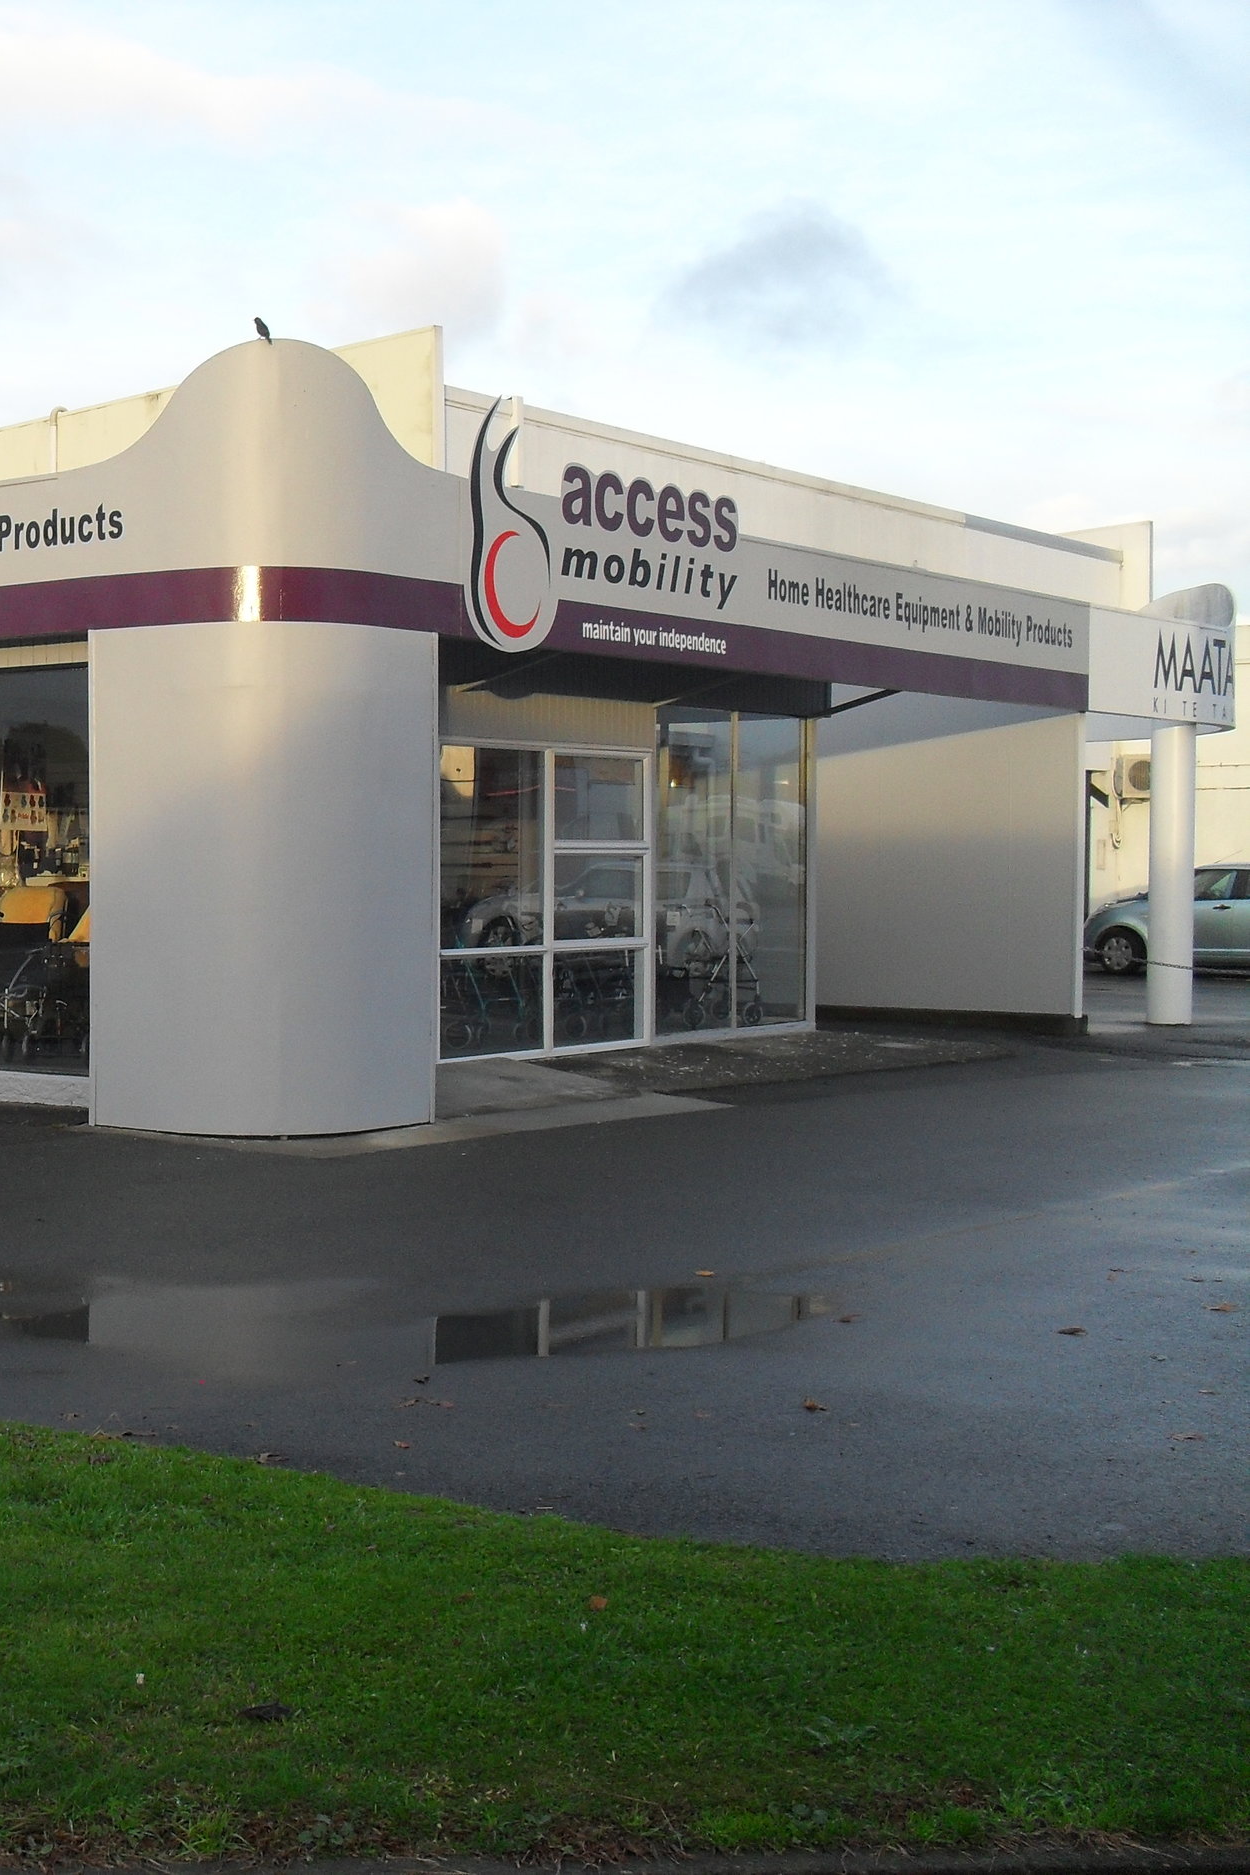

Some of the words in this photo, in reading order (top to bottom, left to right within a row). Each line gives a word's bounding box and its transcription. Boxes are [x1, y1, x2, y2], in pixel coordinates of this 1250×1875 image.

[561, 465, 738, 553] access
[560, 547, 738, 610] mobility
[767, 567, 810, 607] Home
[814, 576, 891, 620] Healthcare
[895, 591, 961, 633] Equipment
[964, 603, 974, 632] &
[977, 606, 1023, 647] Mobility
[1025, 615, 1074, 649] Products
[582, 619, 631, 643] maintain
[633, 627, 658, 646] your
[659, 627, 727, 655] independence
[1153, 697, 1167, 714] KI
[1182, 700, 1198, 718] TE
